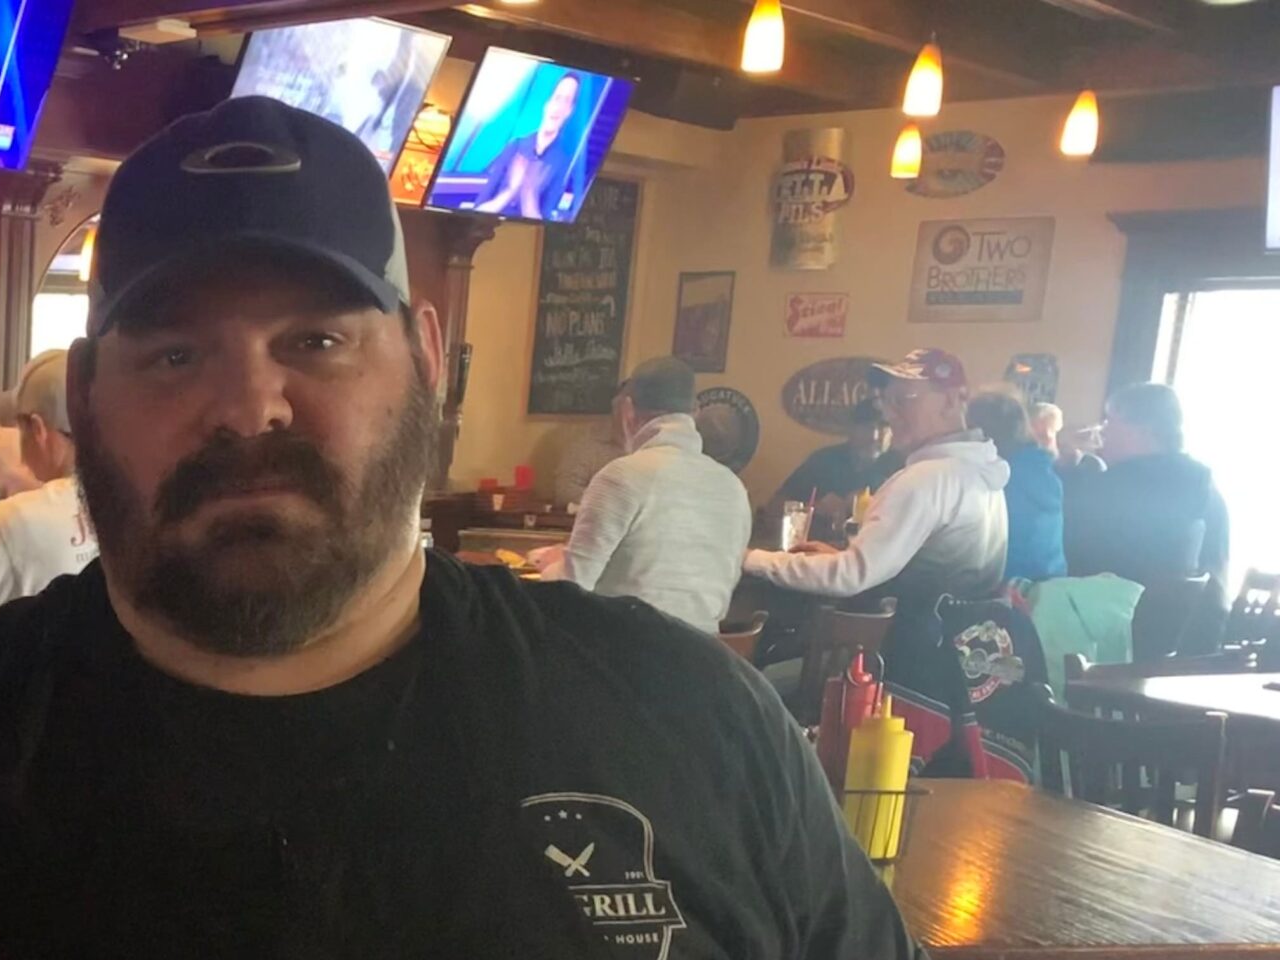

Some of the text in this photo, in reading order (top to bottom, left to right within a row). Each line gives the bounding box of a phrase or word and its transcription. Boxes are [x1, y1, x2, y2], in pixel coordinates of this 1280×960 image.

[972, 231, 1033, 263] TWO
[926, 265, 1027, 294] BROTHERS
[615, 932, 659, 945] HOUSE
